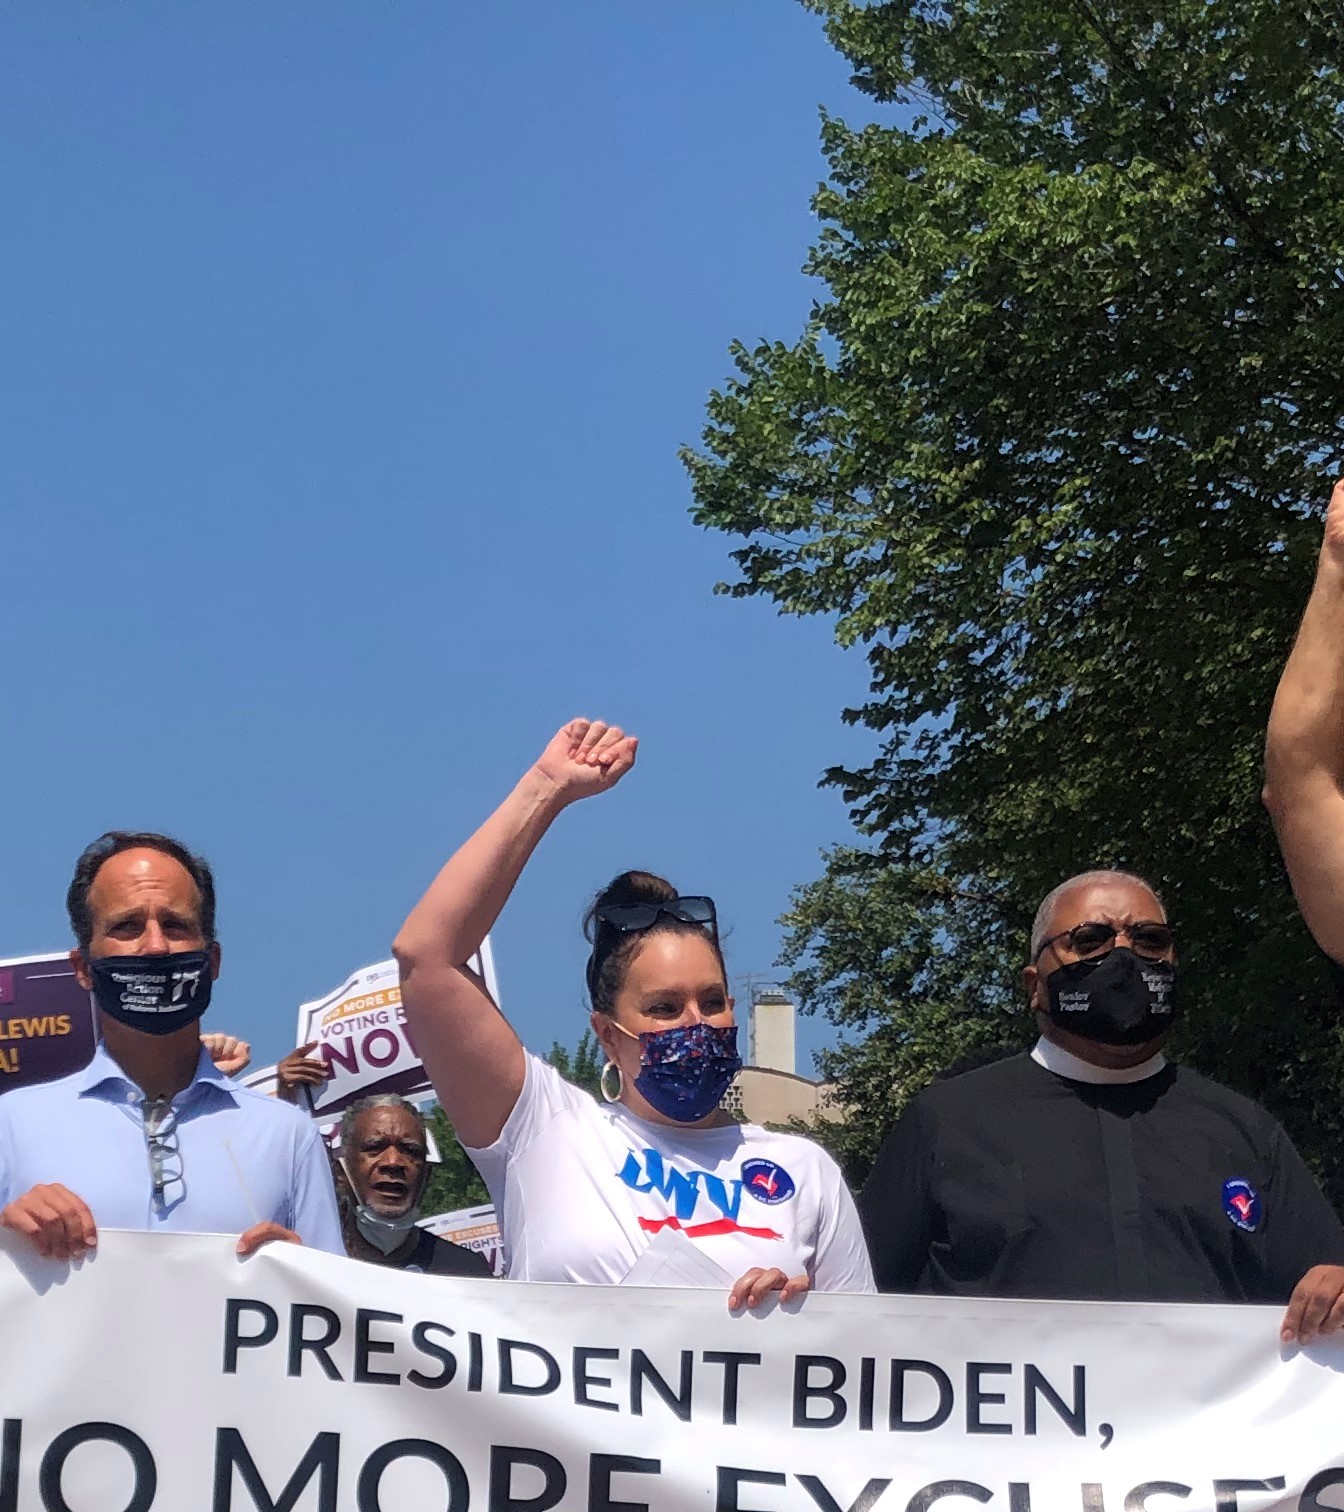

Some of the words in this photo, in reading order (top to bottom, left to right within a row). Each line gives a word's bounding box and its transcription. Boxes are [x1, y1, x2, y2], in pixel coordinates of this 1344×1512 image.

[321, 1010, 389, 1039] VOTING
[343, 993, 385, 1013] MORE
[614, 1147, 746, 1222] LWV
[222, 1298, 762, 1426] PRESIDENT
[792, 1354, 1116, 1450] BIDEN,
